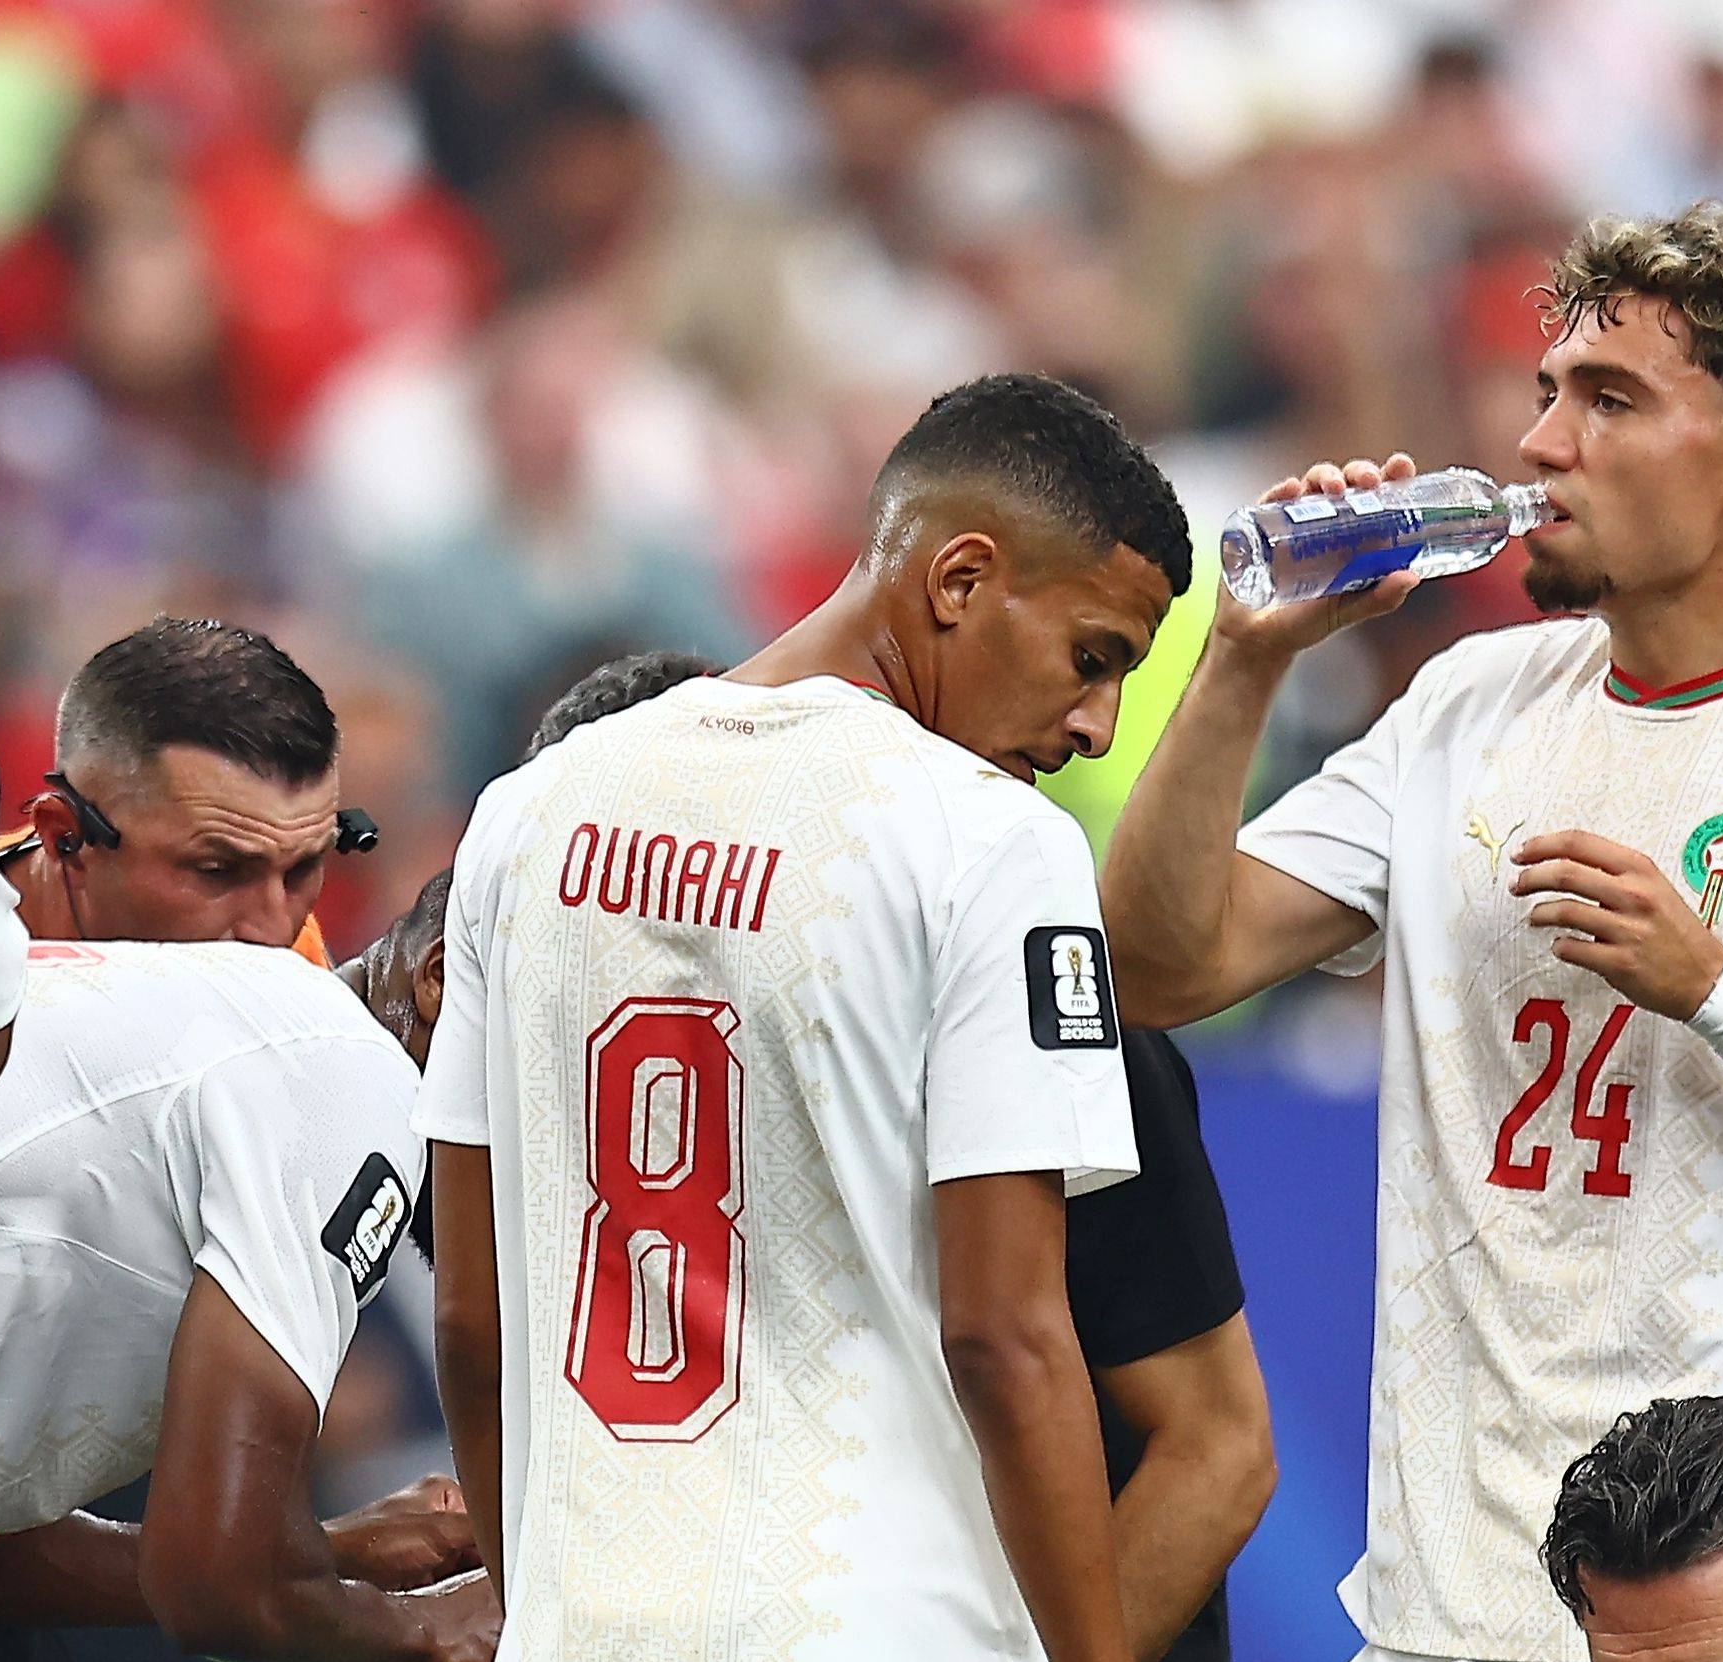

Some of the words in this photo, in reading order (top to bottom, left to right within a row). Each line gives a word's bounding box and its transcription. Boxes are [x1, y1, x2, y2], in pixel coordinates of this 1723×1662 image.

[558, 822, 784, 933] OUNAHI
[1059, 1018, 1087, 1027] WORLD
[1071, 1000, 1090, 1008] FIFA
[1485, 997, 1637, 1198] 24
[563, 995, 746, 1443] 8
